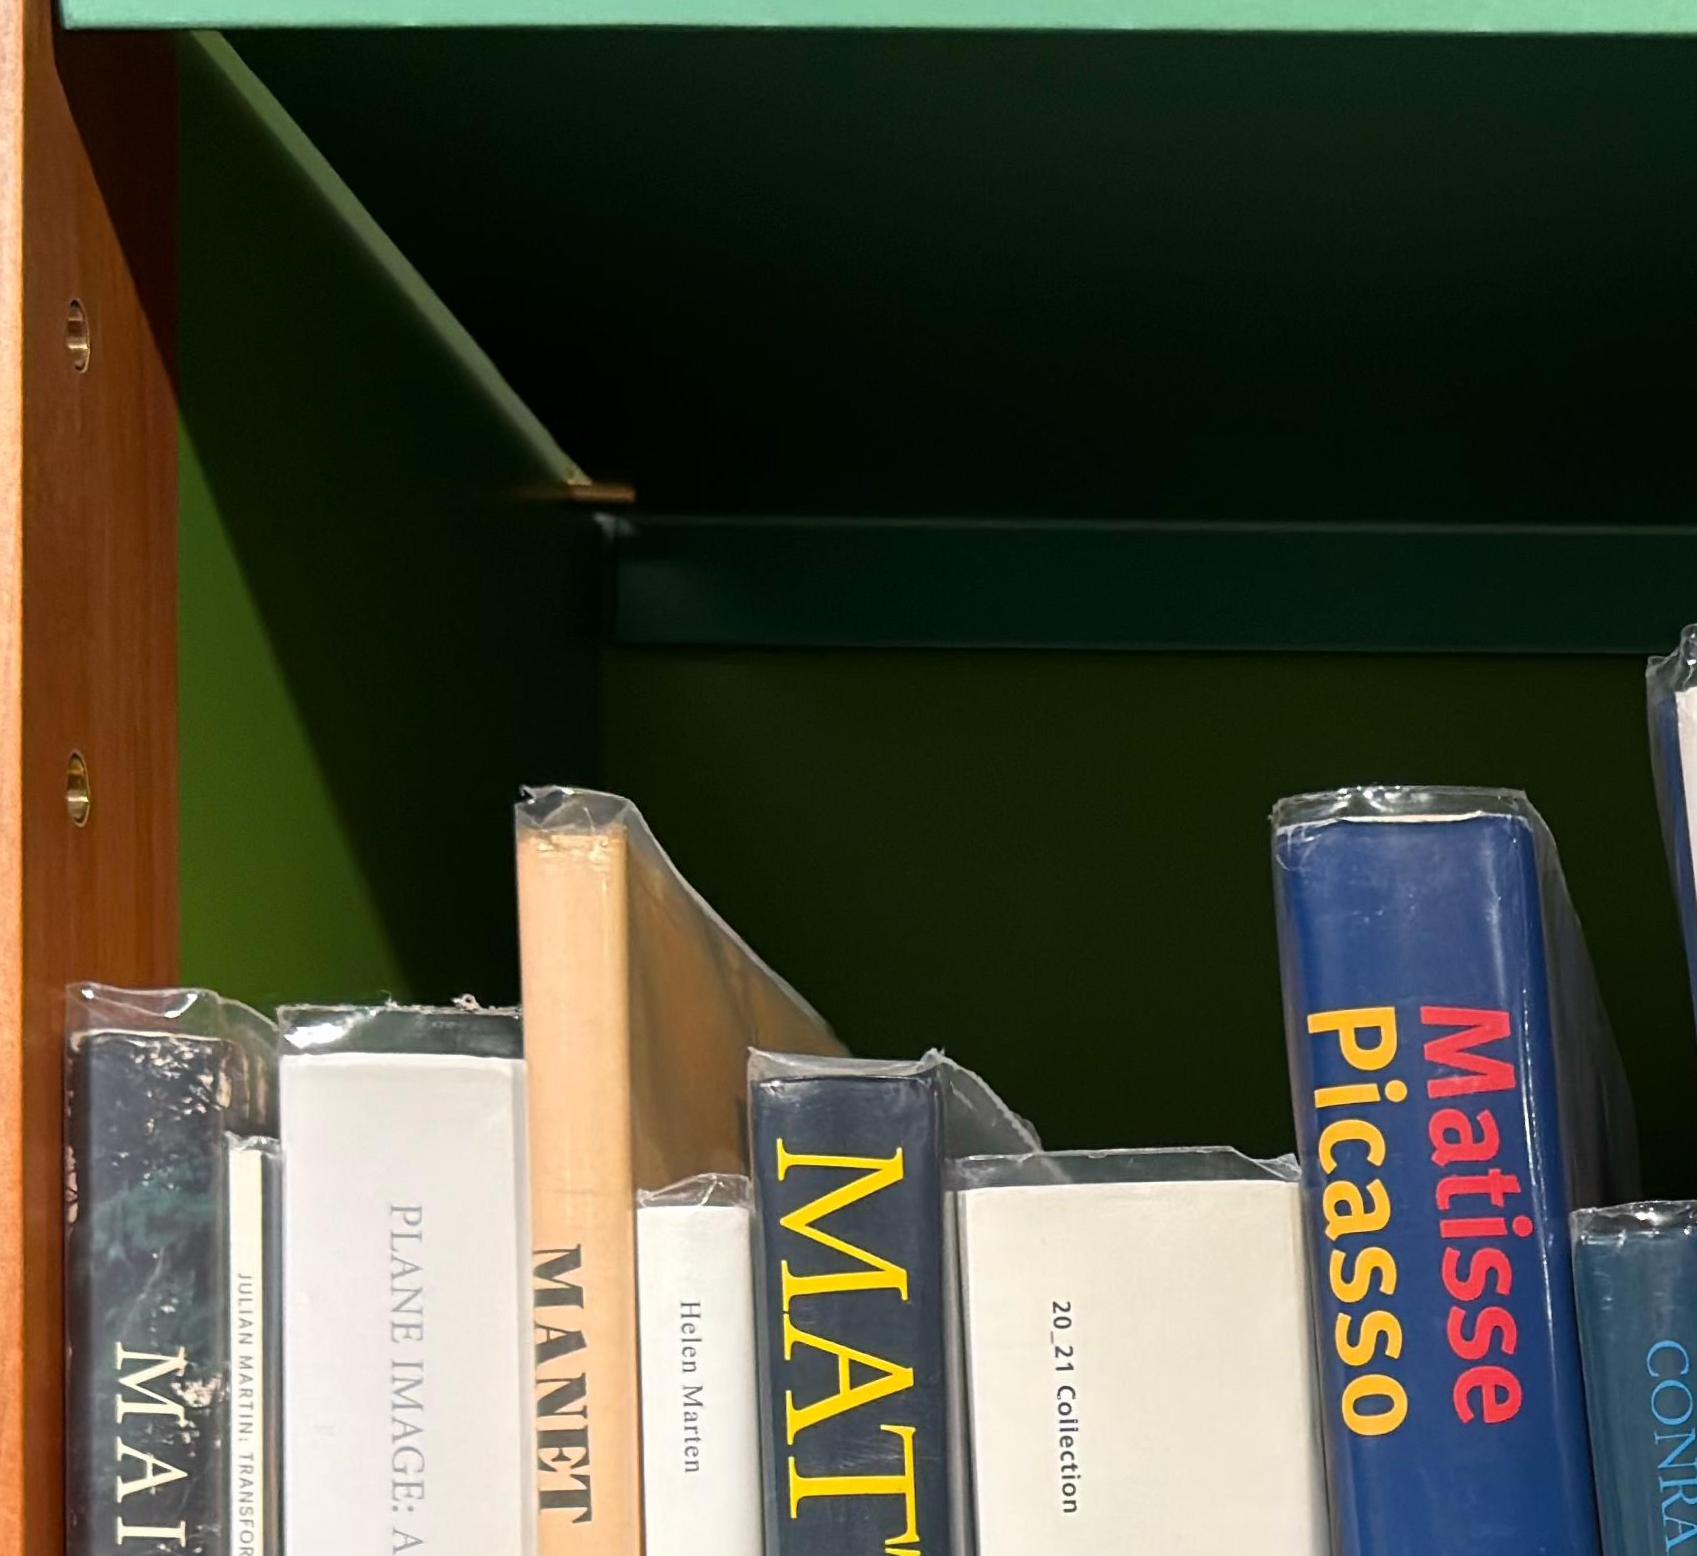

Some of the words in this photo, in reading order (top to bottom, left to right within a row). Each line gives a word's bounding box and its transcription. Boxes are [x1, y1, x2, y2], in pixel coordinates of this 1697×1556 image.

[389, 1202, 425, 1344] PLANE
[1307, 1006, 1409, 1436] Picasso
[1419, 1004, 1534, 1425] Matisse
[238, 1271, 253, 1346] JULIAN
[679, 1300, 699, 1376] Helen
[1050, 1300, 1075, 1376] 20_21
[238, 1351, 253, 1443] MARTIN:
[390, 1357, 427, 1515] IMAGE:
[531, 1243, 594, 1525] MANET
[681, 1385, 701, 1474] Marten
[1055, 1384, 1080, 1515] Collection
